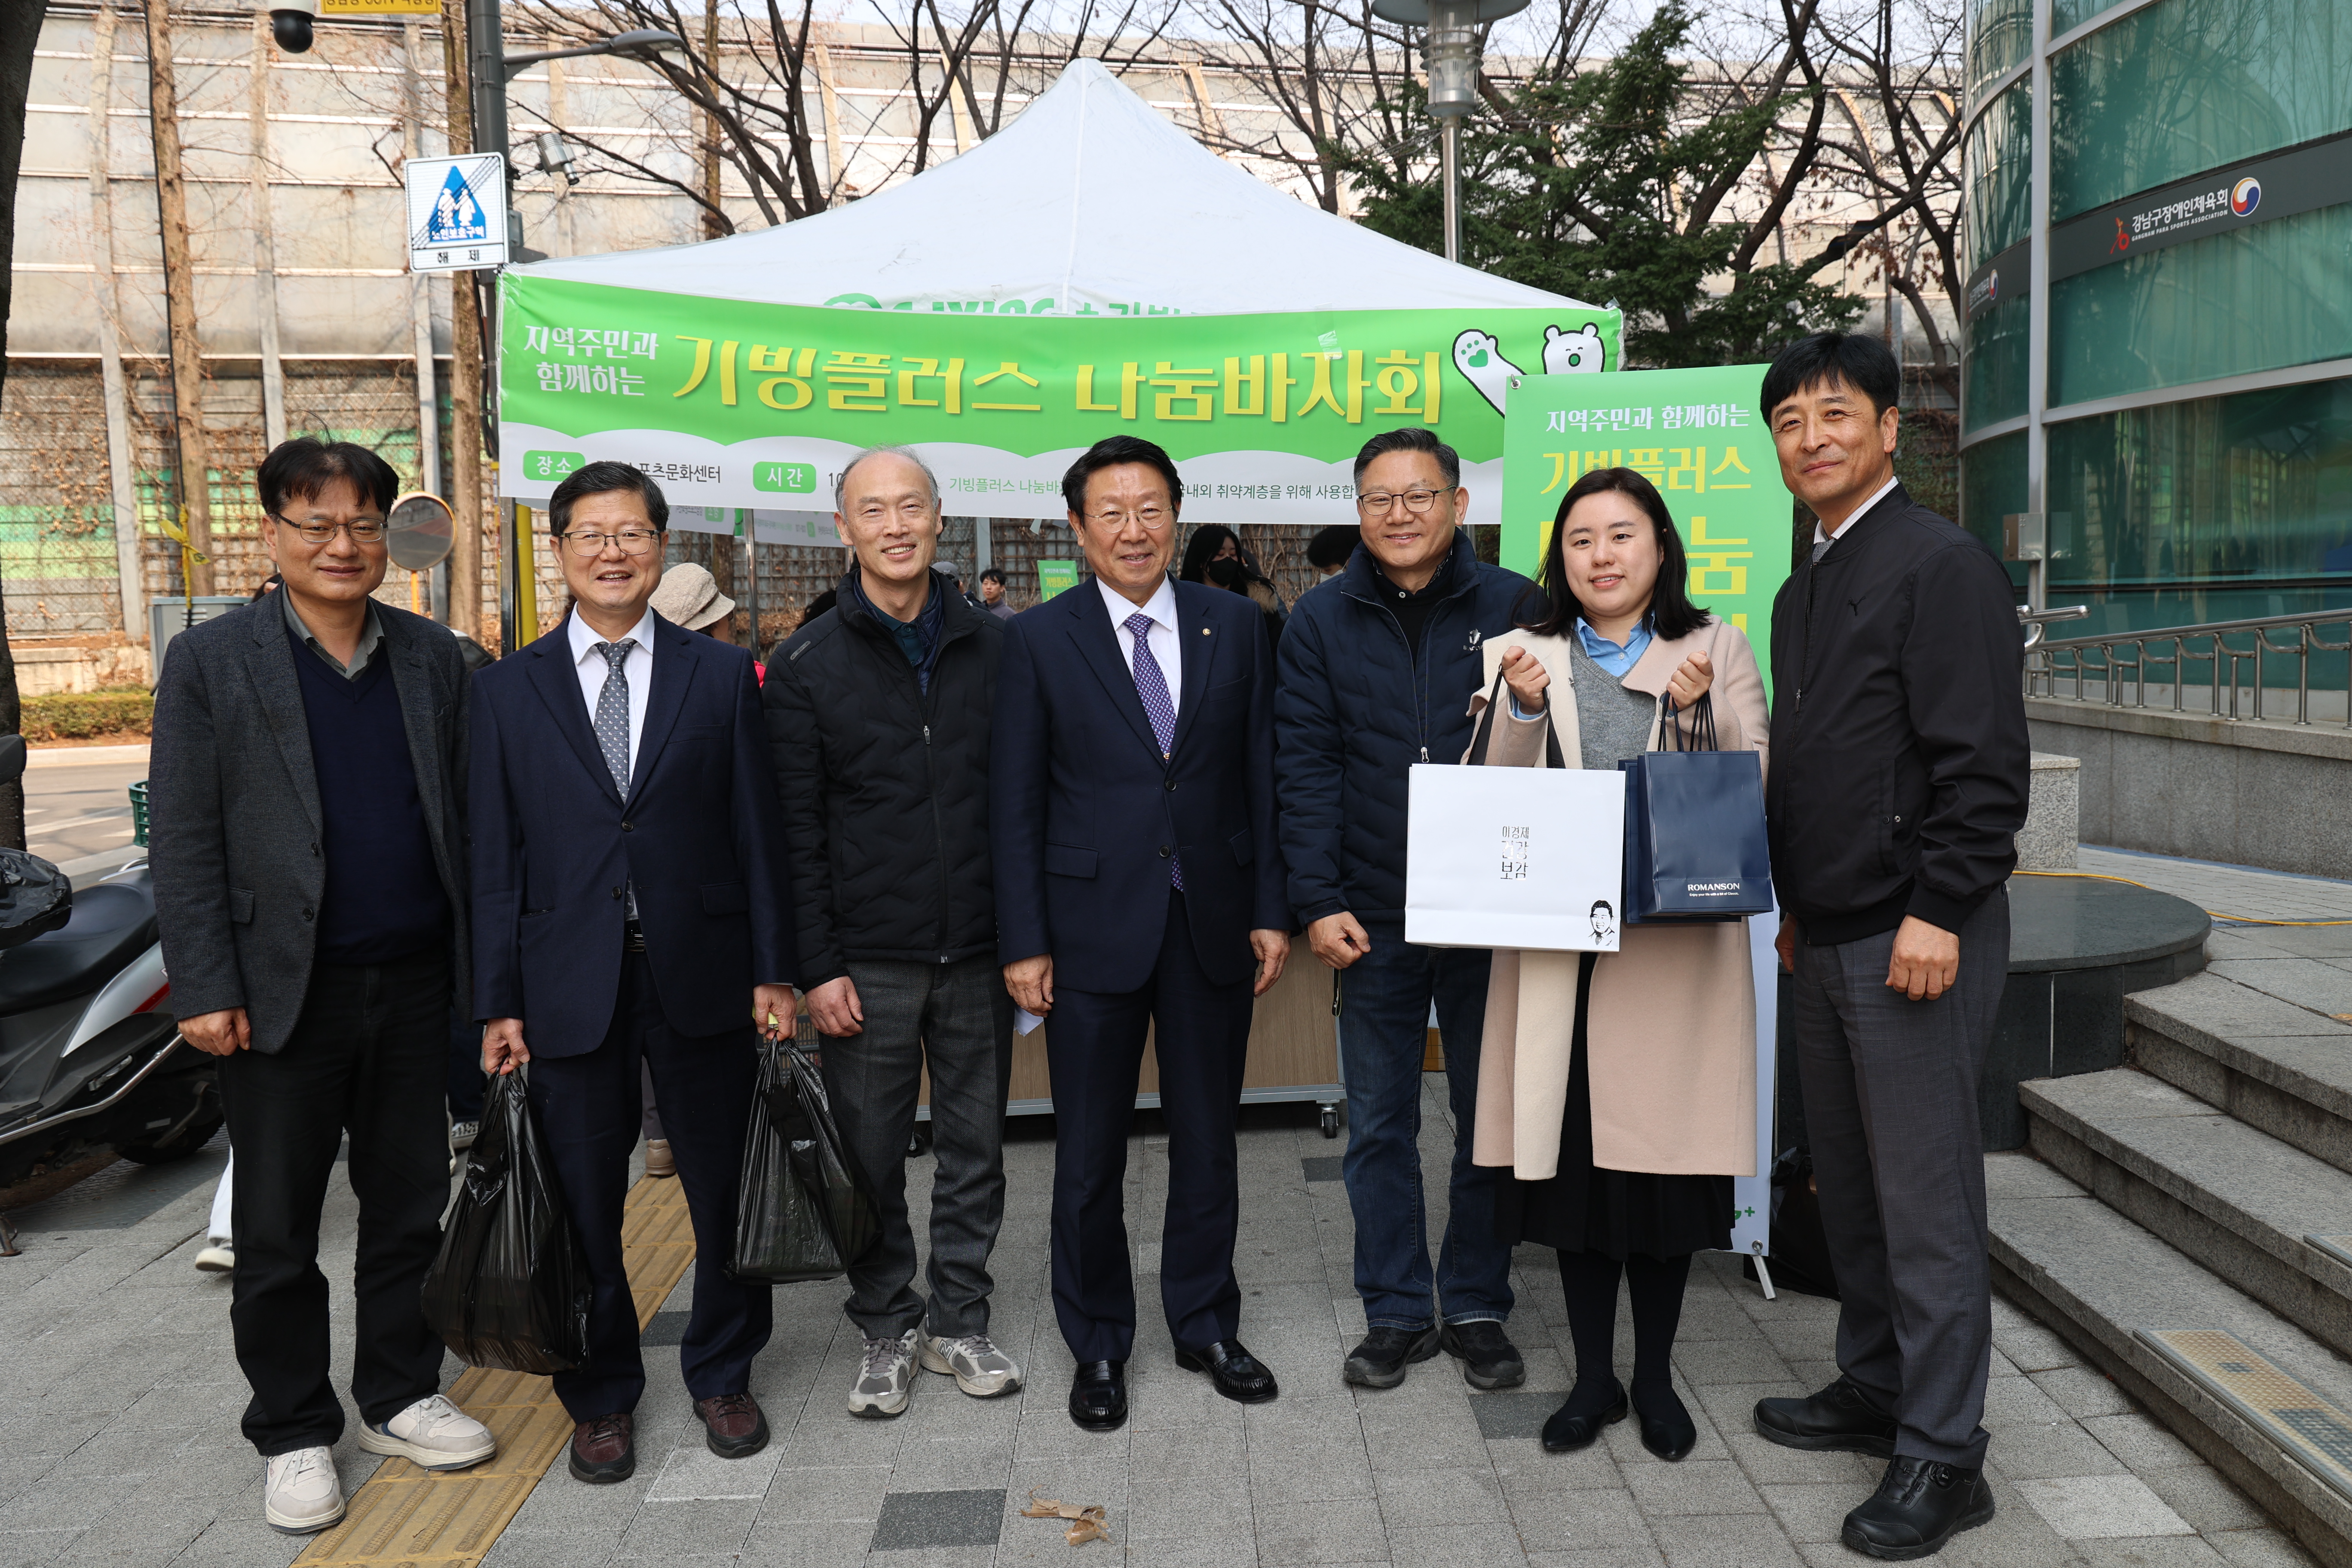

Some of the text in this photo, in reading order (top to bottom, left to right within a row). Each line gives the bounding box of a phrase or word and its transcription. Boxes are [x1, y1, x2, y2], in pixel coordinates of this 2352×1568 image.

[2132, 188, 2228, 233] 강남구장애인체육회
[432, 225, 484, 240] 노인보호구역
[2132, 209, 2228, 242] GANGNAM PARA SPORTS ASSOCIATION
[524, 325, 659, 360] 지역주민과
[536, 361, 645, 396] 함께하는
[673, 334, 1440, 423] 기빙플러스 나눔바자회
[1546, 404, 1750, 433] 지역주민과 함께하는
[767, 467, 802, 487] 시간
[949, 478, 1015, 493] 기빙플러스
[1216, 484, 1282, 499] 취약계층을
[1286, 485, 1311, 499] 위해
[1502, 826, 1529, 839] 이경제
[1501, 840, 1529, 860] 건강
[1500, 861, 1528, 880] 보감
[1687, 883, 1740, 891] ROMANSON
